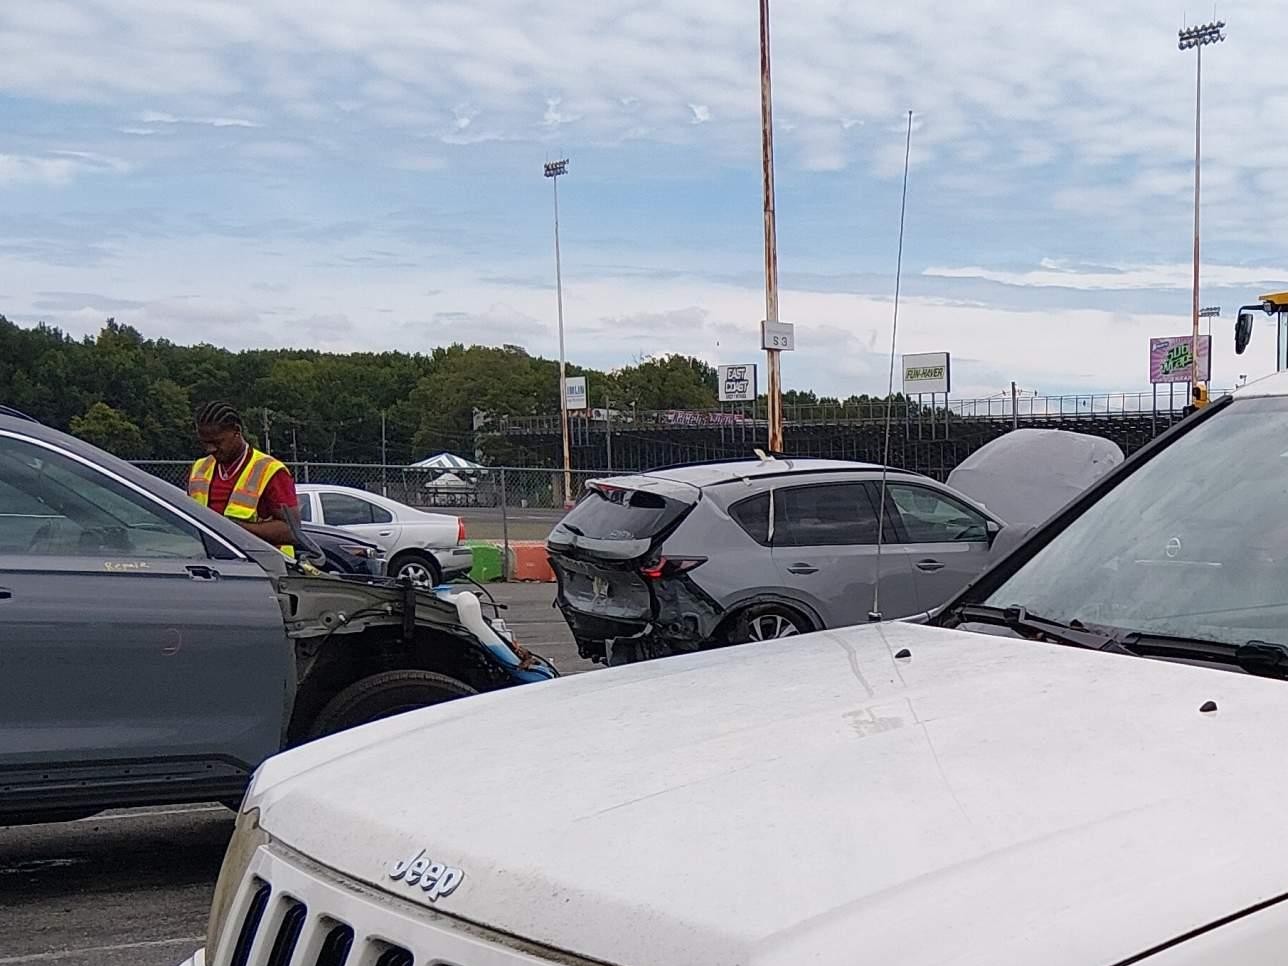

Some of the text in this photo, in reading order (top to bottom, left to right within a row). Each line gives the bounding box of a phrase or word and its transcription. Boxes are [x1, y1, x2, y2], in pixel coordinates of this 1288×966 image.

[727, 366, 747, 381] EAST
[724, 379, 749, 394] COAST
[388, 848, 465, 903] Jeep
